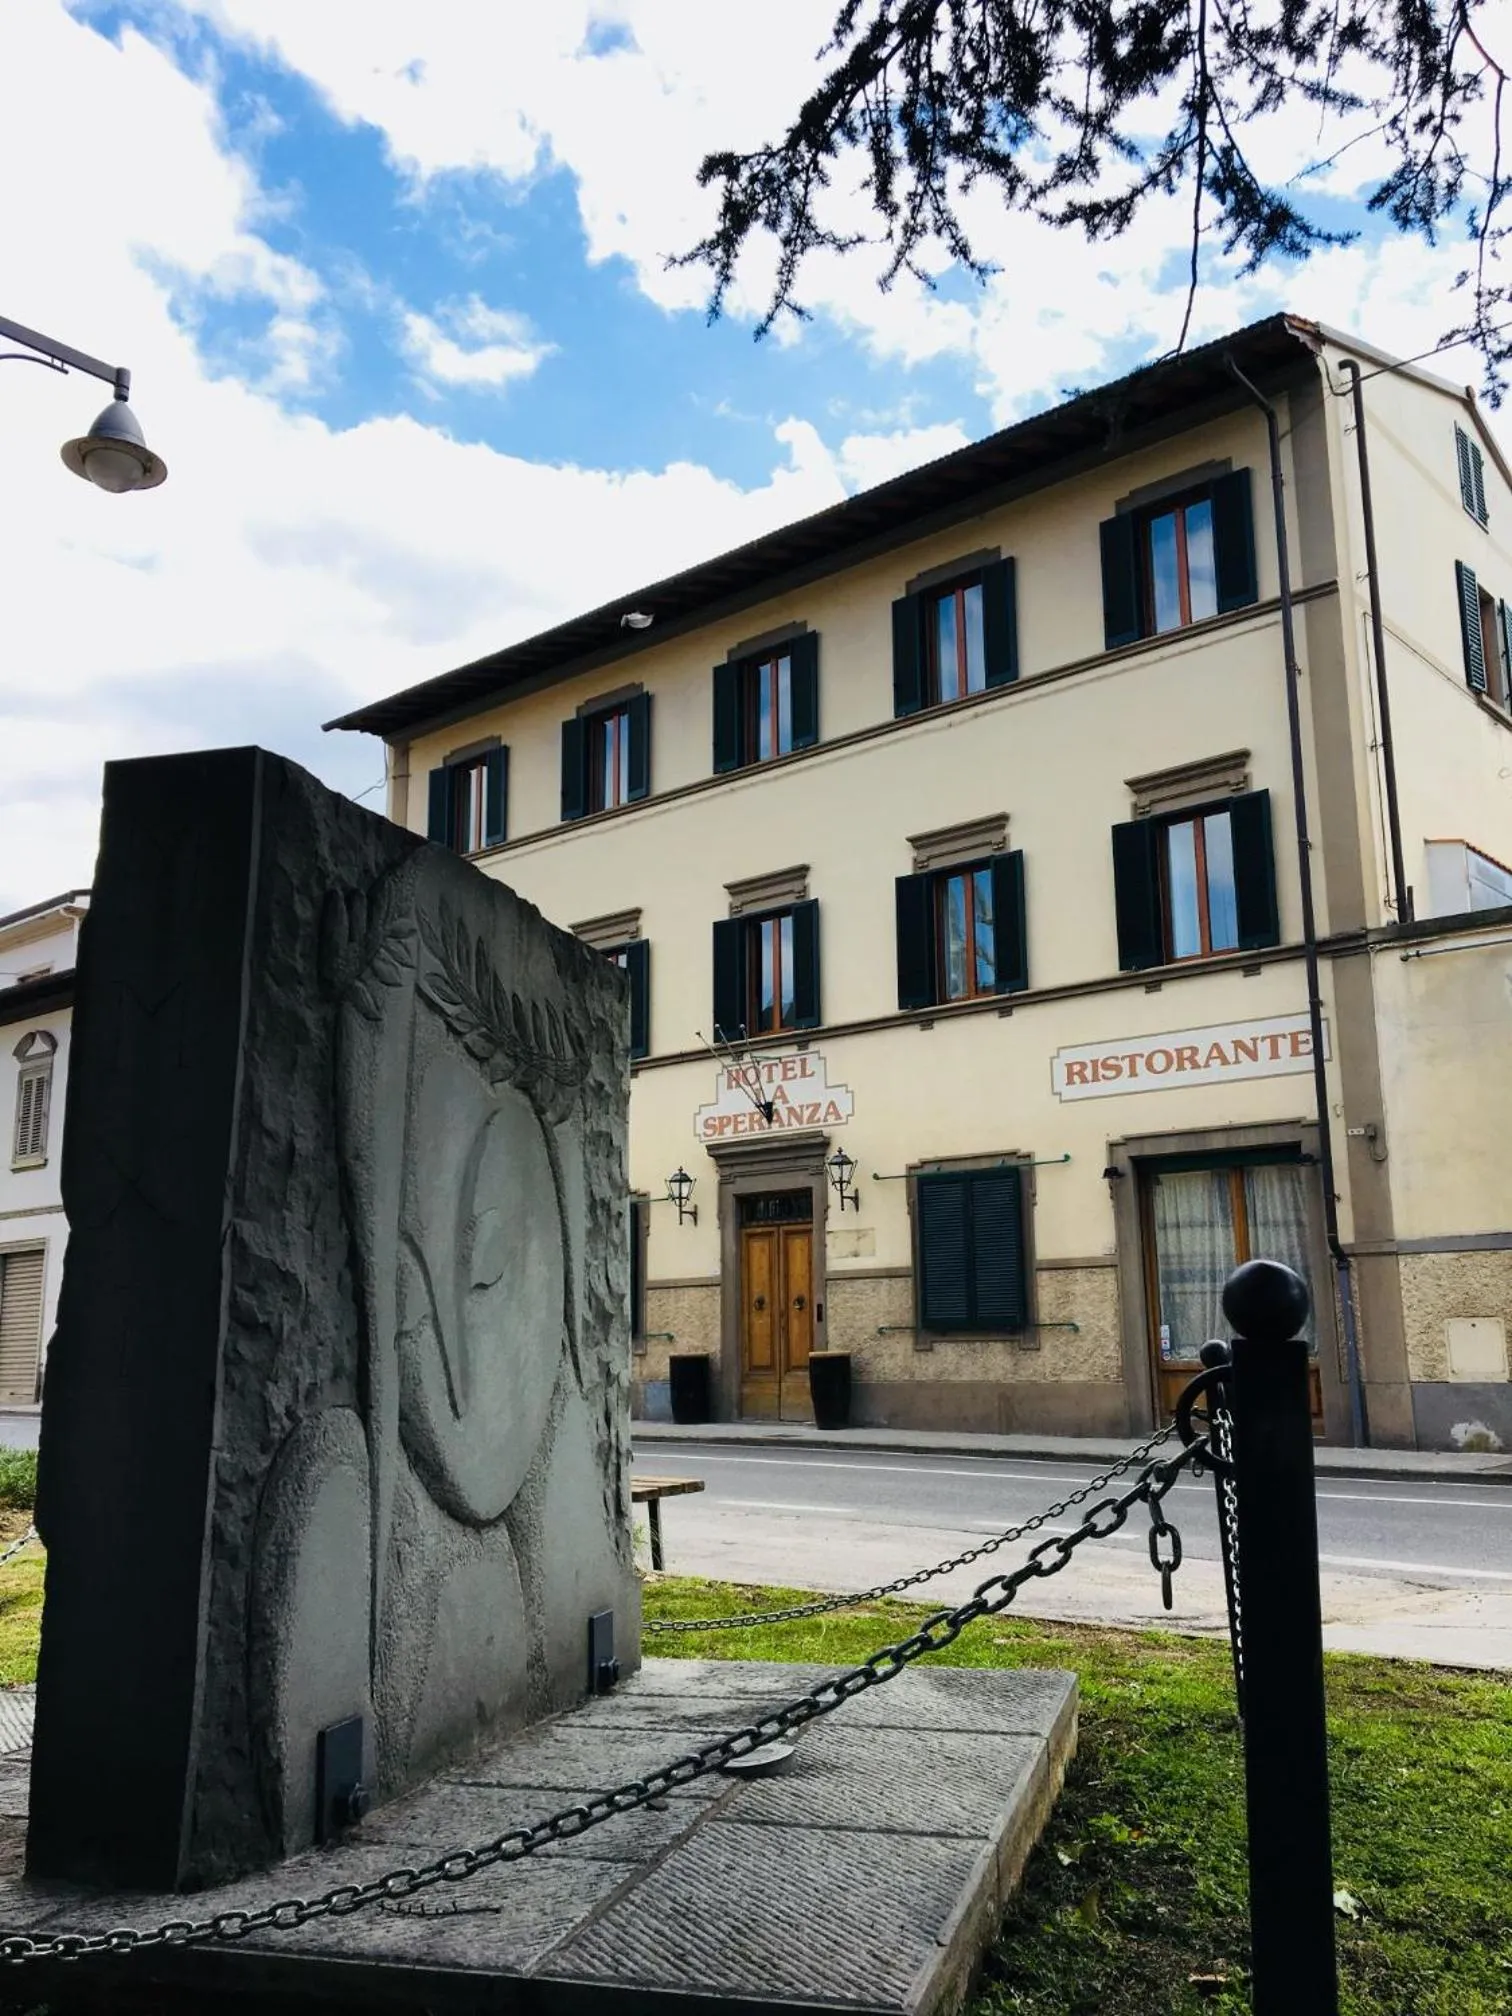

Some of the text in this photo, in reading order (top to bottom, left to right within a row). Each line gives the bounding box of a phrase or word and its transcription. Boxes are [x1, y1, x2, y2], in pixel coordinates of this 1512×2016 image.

[726, 1057, 816, 1090] HOTEL
[1065, 1029, 1314, 1086] RISTORANTE
[702, 1100, 843, 1138] SPERANZA
